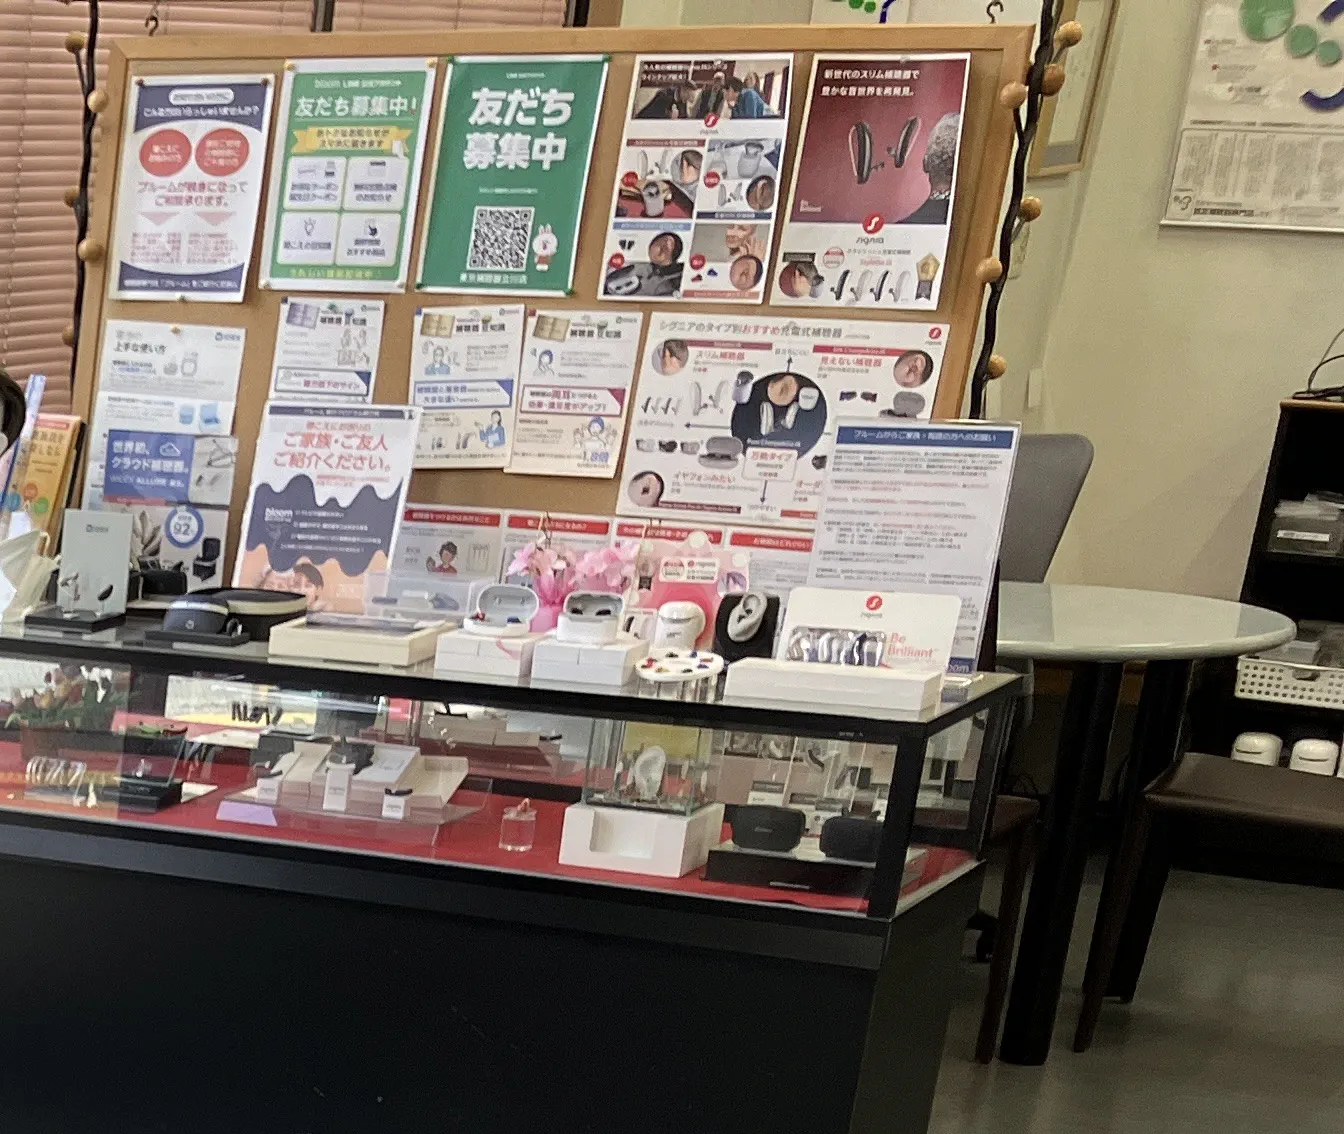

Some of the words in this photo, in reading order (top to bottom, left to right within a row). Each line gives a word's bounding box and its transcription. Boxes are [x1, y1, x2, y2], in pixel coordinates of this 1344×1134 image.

[468, 86, 575, 126] 友だち
[463, 132, 568, 170] 募集中
[284, 431, 389, 452] ご家族・ご友人
[273, 450, 391, 473] ご紹介ください。
[890, 632, 907, 644] Be
[886, 644, 934, 658] Brilliant
